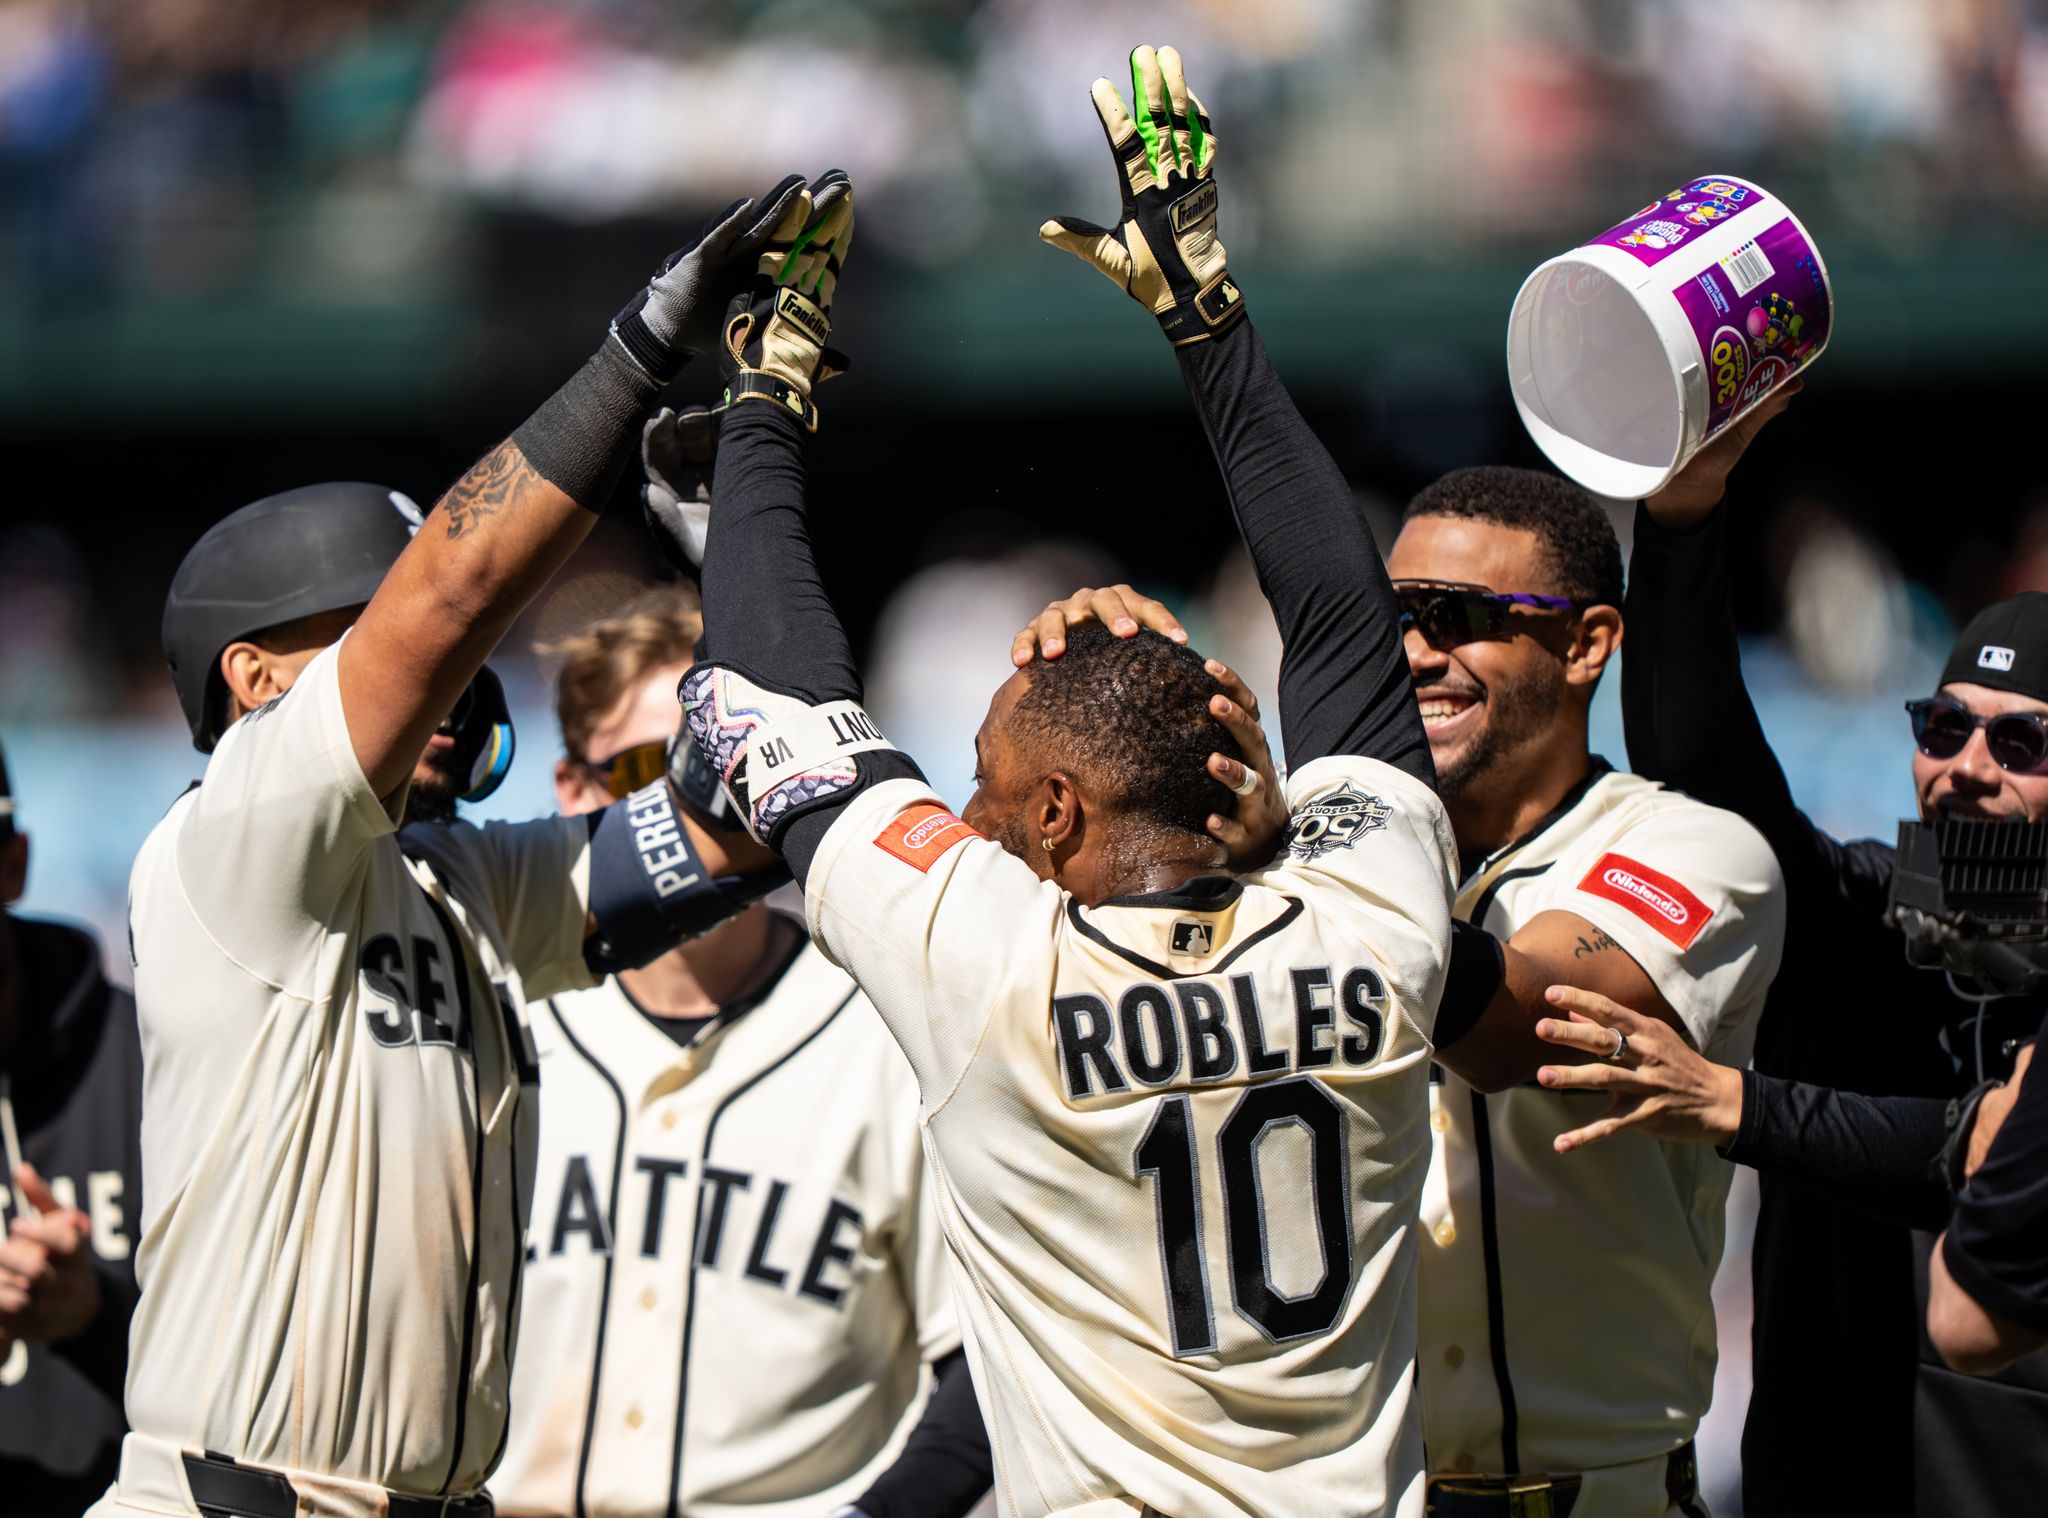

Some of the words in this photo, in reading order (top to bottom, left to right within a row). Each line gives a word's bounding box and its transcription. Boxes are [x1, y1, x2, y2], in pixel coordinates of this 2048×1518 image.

[1178, 188, 1215, 229] Franklin
[780, 293, 826, 340] Franklin
[1713, 341, 1736, 404] 300
[1734, 344, 1745, 381] PIECES
[760, 736, 794, 769] VR
[626, 776, 699, 898] PERED
[1293, 813, 1362, 843] 50
[1611, 872, 1681, 918] Nintendo
[358, 932, 471, 1050] SE
[1053, 967, 1386, 1100] ROBLES
[526, 1155, 864, 1312] ATTLE
[1133, 1073, 1353, 1357] 10
